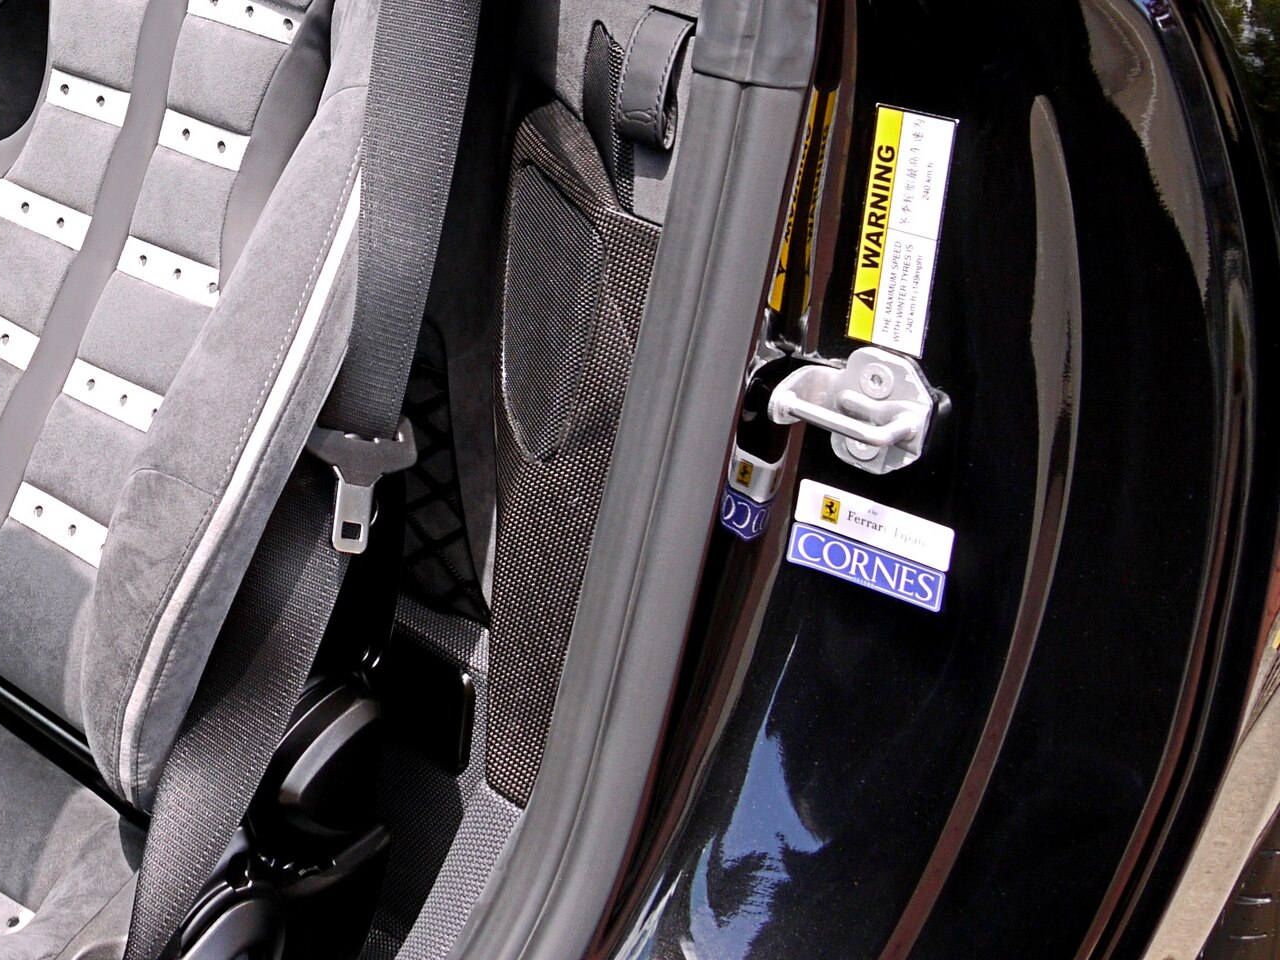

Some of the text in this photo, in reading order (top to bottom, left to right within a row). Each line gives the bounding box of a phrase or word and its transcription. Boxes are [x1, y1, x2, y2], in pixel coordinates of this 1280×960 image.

[861, 144, 895, 269] WARNING
[921, 160, 934, 201] 240 kmh
[881, 240, 902, 333] THE MAXIMUM SPEED
[891, 242, 913, 342] WITH WINTER TYRES IS
[907, 294, 917, 316] kmh
[905, 316, 914, 333] 240
[847, 510, 886, 533] Ferrari
[797, 532, 935, 602] CORNES
